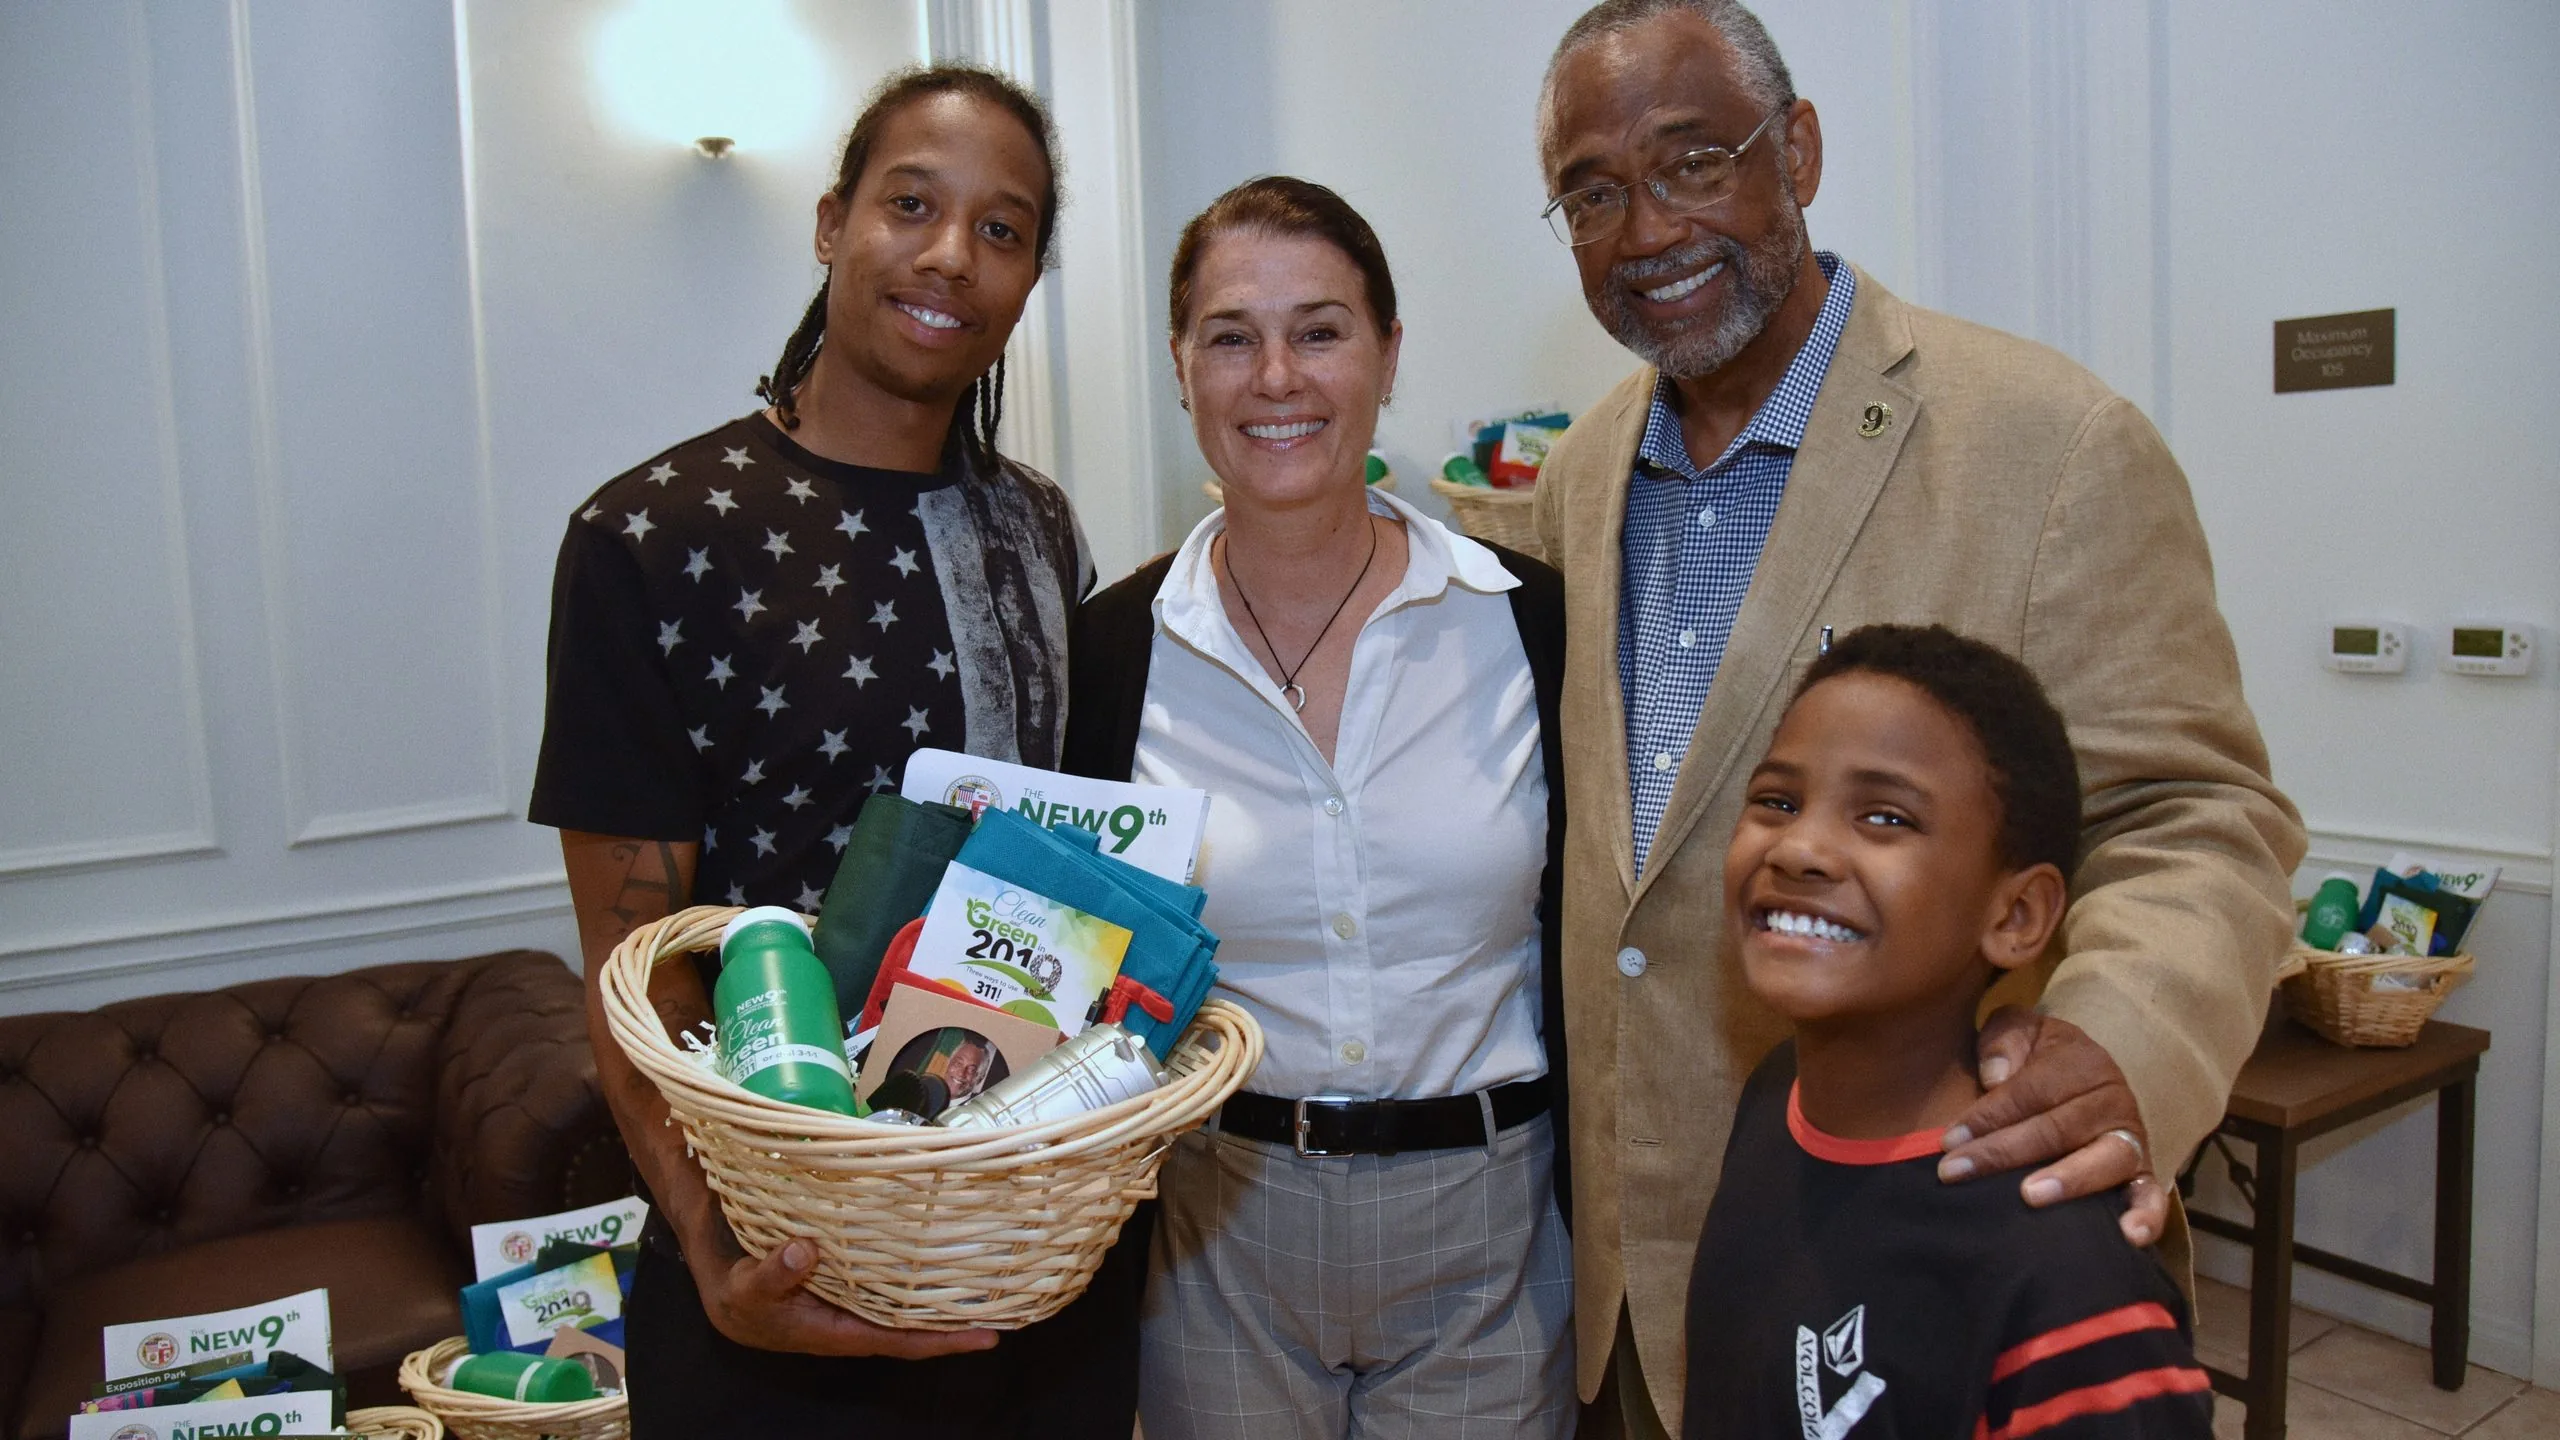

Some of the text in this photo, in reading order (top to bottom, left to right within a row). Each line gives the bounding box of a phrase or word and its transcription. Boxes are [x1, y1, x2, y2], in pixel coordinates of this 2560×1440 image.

[2291, 343, 2373, 362] Occupancy
[1023, 787, 1045, 800] THE
[1018, 797, 1108, 834] NEW
[993, 890, 1047, 929] Clean
[966, 897, 1046, 954] Green in
[966, 966, 1019, 992] Three ways to use
[973, 980, 1003, 1002] 311!
[736, 993, 764, 1014] NEW
[728, 1017, 785, 1054] Clean
[191, 1326, 256, 1353] NEW
[106, 1369, 187, 1394] Exposition Park
[174, 1419, 192, 1428] THE
